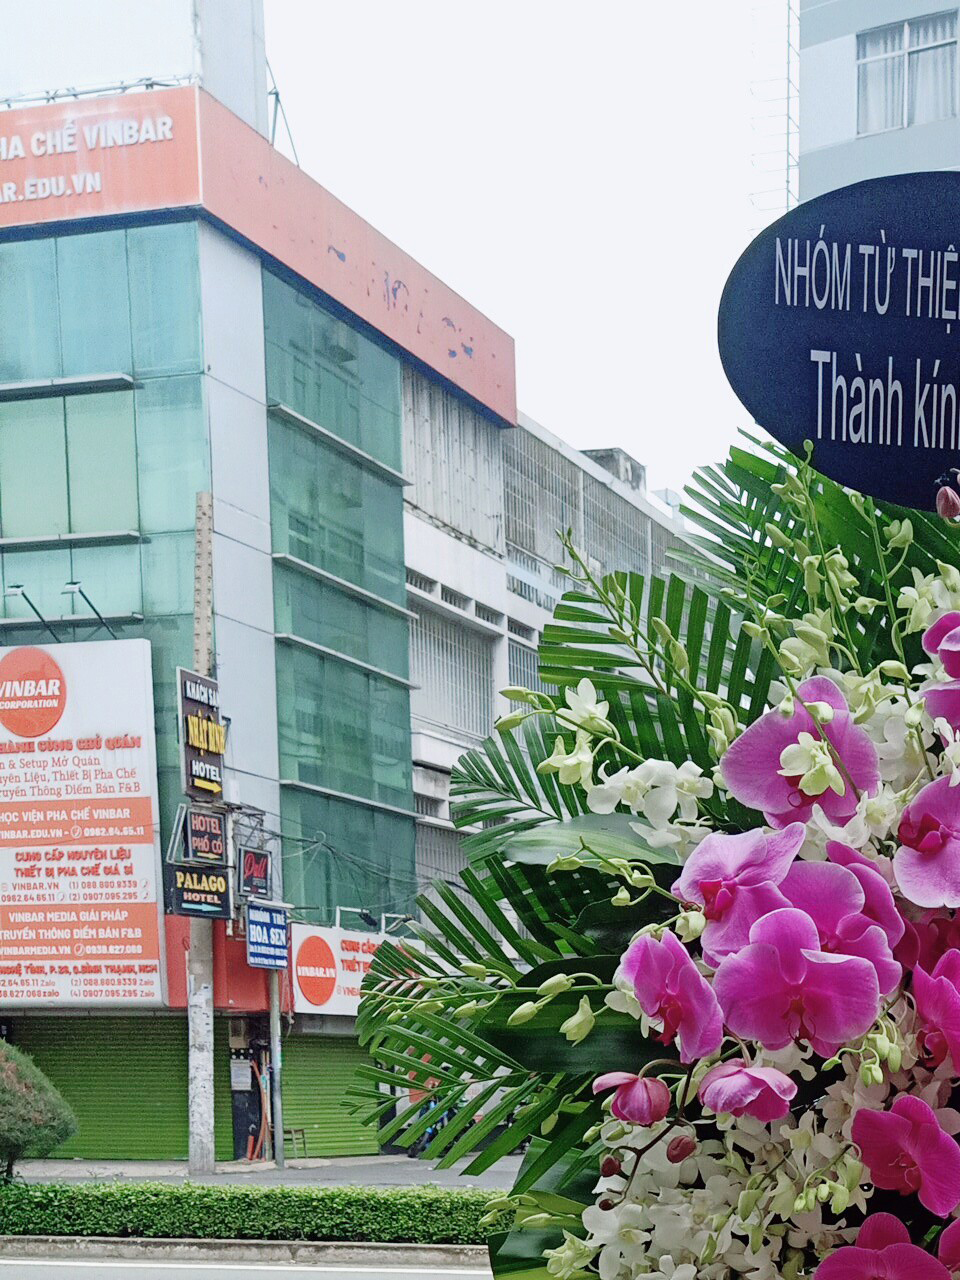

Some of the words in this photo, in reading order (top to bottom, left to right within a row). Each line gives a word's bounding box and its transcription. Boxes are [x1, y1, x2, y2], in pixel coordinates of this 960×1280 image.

[30, 115, 78, 157] CHẾ
[83, 115, 173, 150] VINBAR
[0, 172, 102, 203] R.EDU.VN
[774, 224, 852, 312] NHÓM
[858, 229, 896, 315] TỪ
[810, 349, 902, 447] Thành
[9, 759, 17, 770] &
[20, 758, 49, 771] Setup
[52, 756, 68, 767] Mở
[72, 756, 101, 768] Quán
[191, 760, 221, 782] HOTEL
[94, 769, 114, 780] Pha
[30, 787, 62, 799] Thông
[96, 784, 116, 794] Bán
[118, 782, 141, 794] F&B
[22, 809, 44, 825] VIỆN
[47, 811, 68, 821] PHA
[70, 806, 91, 820] CHẾ
[92, 808, 131, 820] VINBAR
[191, 814, 221, 834] HOTEL
[57, 867, 78, 877] PHA
[12, 882, 60, 891] VINBAR.VN
[175, 871, 226, 893] PALAGO
[183, 892, 222, 904] HOTEL
[9, 912, 45, 923] VINBAR
[47, 911, 78, 922] MEDIA
[101, 908, 128, 921] PHÁP
[38, 927, 71, 939] THÔNG
[99, 926, 120, 938] BÁN
[121, 928, 142, 938] F&B
[249, 924, 270, 944] HOA
[269, 927, 287, 946] SEN
